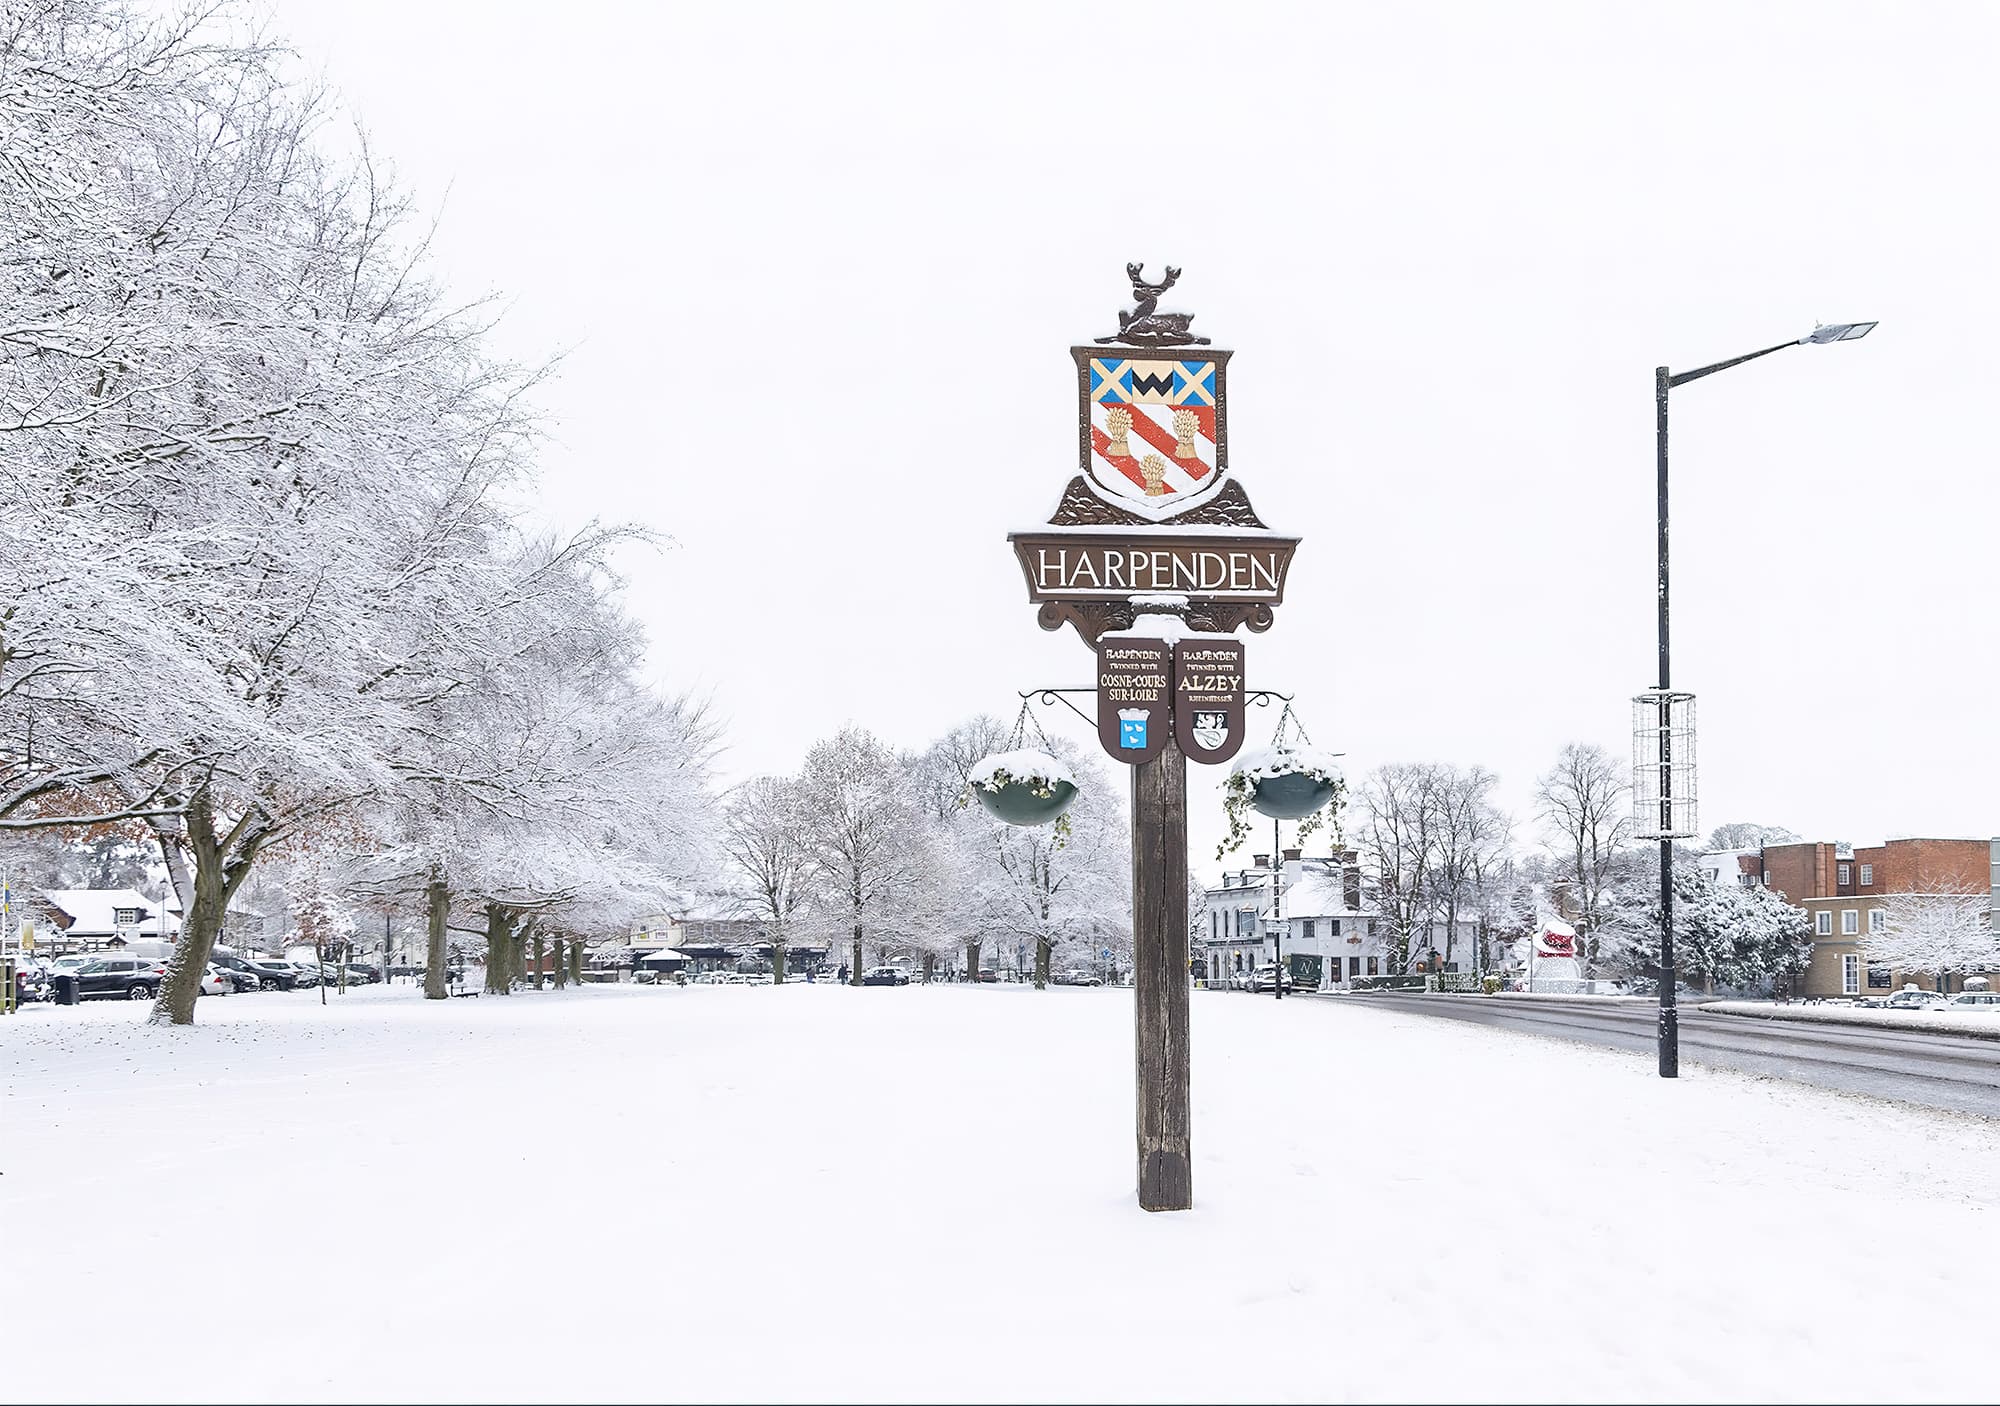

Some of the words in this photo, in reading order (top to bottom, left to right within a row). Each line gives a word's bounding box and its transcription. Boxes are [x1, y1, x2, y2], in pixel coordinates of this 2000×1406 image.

[1037, 549, 1277, 590] HARPENDEN
[1105, 649, 1161, 660] HARPENDEN
[1182, 650, 1238, 661] HARPENDEN
[1100, 674, 1166, 688] COSNE-COURS
[1178, 674, 1242, 692] ALZEY
[1109, 688, 1159, 701] SUR-LOIRE
